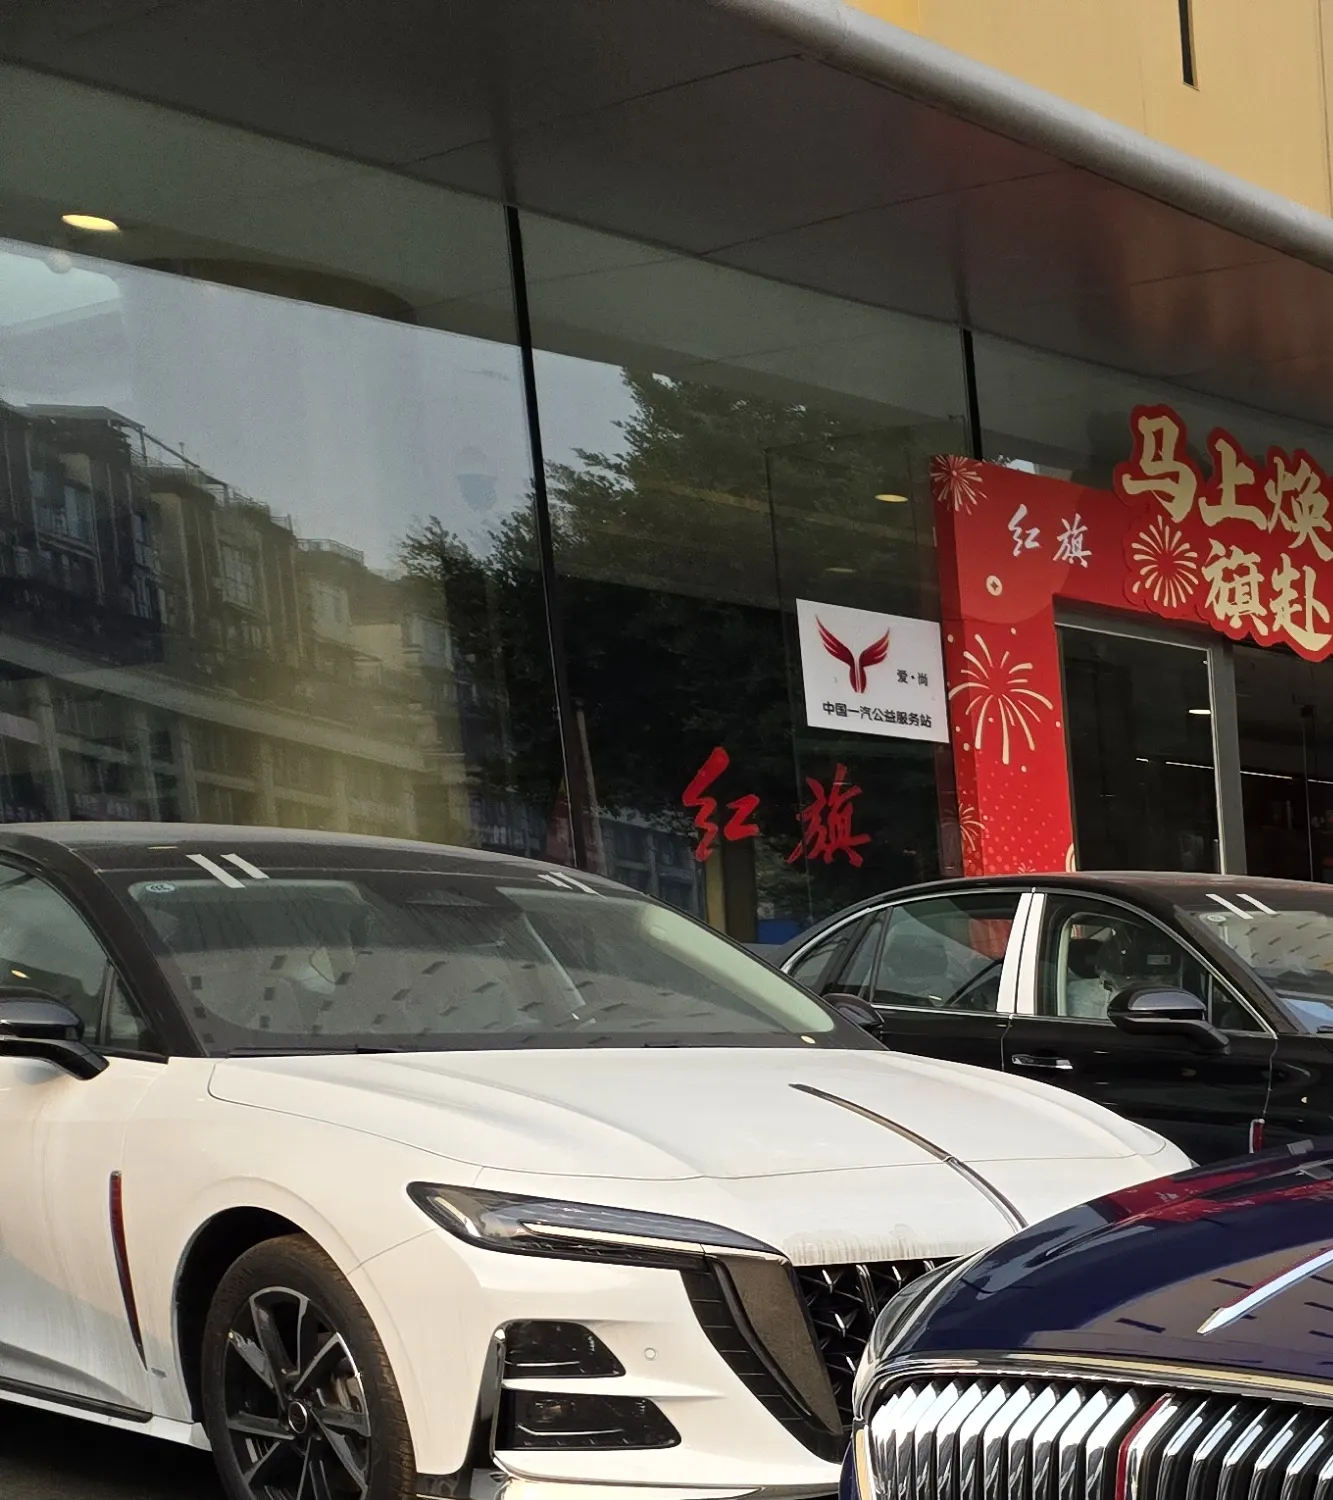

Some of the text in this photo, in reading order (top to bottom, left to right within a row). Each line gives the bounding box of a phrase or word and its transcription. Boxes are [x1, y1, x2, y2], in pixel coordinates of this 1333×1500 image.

[1007, 504, 1092, 568] 红旗
[822, 701, 932, 728] 中国一汽公益服务站
[681, 746, 872, 868] 红旗
